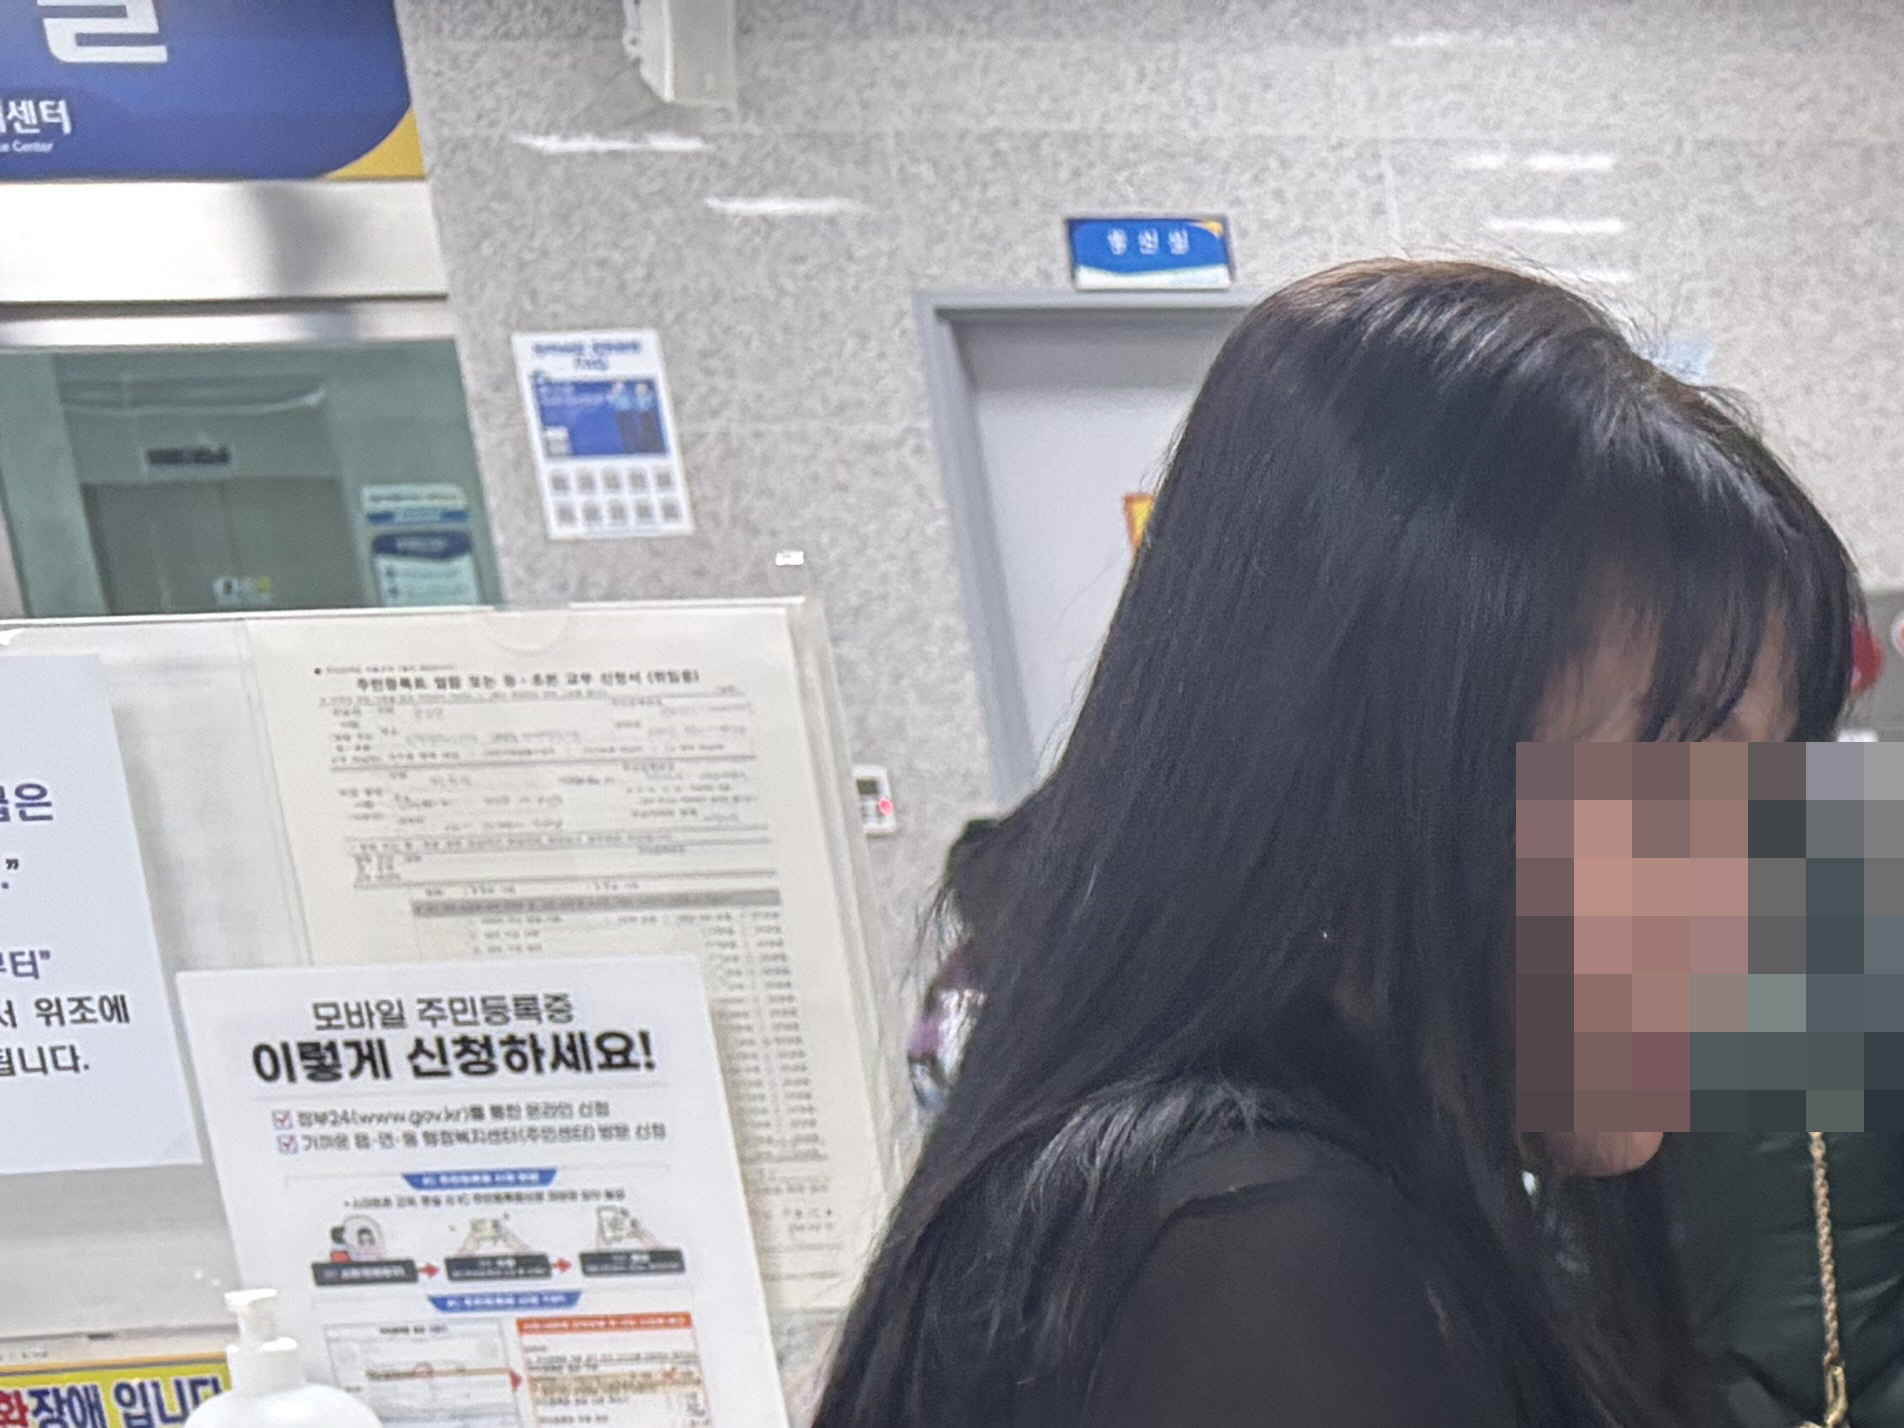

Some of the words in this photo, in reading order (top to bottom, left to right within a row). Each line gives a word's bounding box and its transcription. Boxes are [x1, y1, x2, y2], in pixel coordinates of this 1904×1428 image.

[0, 100, 71, 134] 센터
[0, 949, 50, 980] 터”
[34, 994, 130, 1027] 위조에
[313, 1000, 407, 1031] 모바일
[416, 993, 574, 1028] 주민등록증
[253, 1037, 392, 1083] 이렇게
[407, 1030, 656, 1079] 신청하세요!
